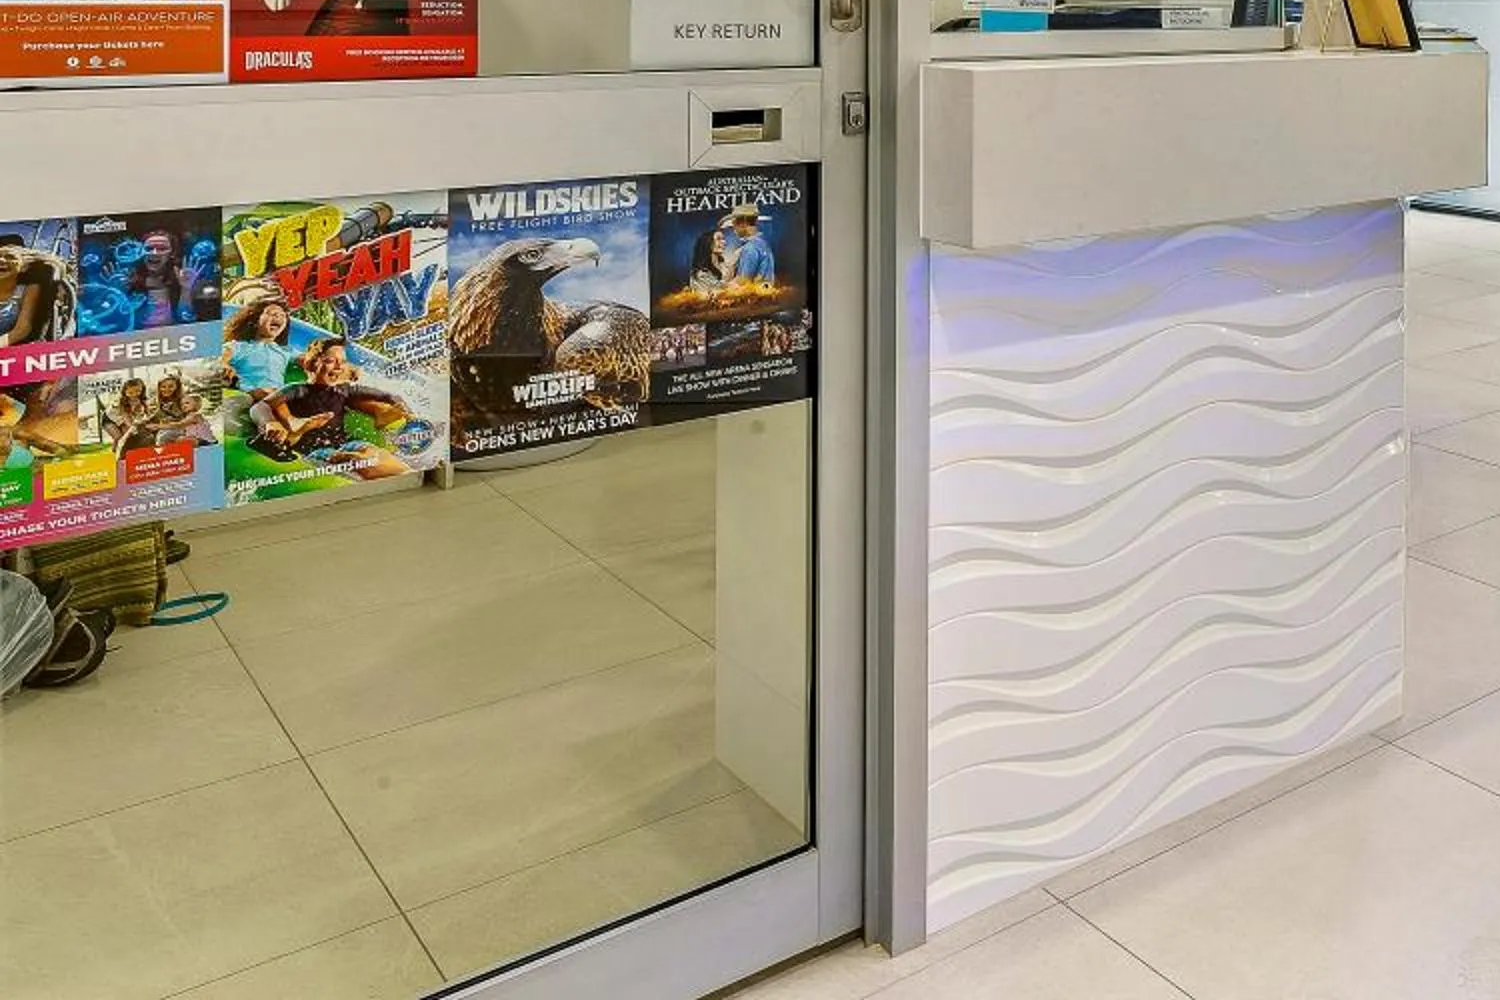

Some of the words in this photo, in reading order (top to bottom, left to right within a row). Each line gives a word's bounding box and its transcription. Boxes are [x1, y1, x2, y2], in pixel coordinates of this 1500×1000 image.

[47, 10, 125, 23] OPEN-AIR
[127, 10, 216, 22] ADVENTURE
[22, 41, 76, 51] Purchase
[77, 42, 102, 51] your
[140, 40, 165, 49] here
[673, 23, 707, 40] KEY
[711, 24, 782, 39] RETURN
[467, 181, 639, 222] WILDSKIES
[667, 187, 802, 213] HEARTLAND
[673, 185, 721, 197] OUTBACK
[471, 219, 504, 232] FREE
[509, 217, 557, 229] FLIGHT
[563, 214, 592, 225] BIRD
[599, 209, 637, 221] SHOW
[234, 204, 343, 278] YEP
[273, 227, 413, 310] YEAH
[25, 347, 99, 373] NEW
[108, 335, 197, 362] FEELS
[512, 374, 596, 403] WILDLIFE
[465, 427, 493, 438] NEW
[500, 421, 538, 434] SHOW
[549, 412, 578, 425] NEW
[465, 433, 518, 453] OPENS
[520, 426, 555, 443] NEW
[558, 417, 607, 436] YEAR'S
[228, 475, 285, 493] PURCHASE
[285, 469, 315, 482] YOUR
[316, 461, 356, 477] TICKETS
[48, 514, 88, 529] YOUR
[90, 503, 147, 520] TICKETS
[149, 495, 187, 509] HERE!
